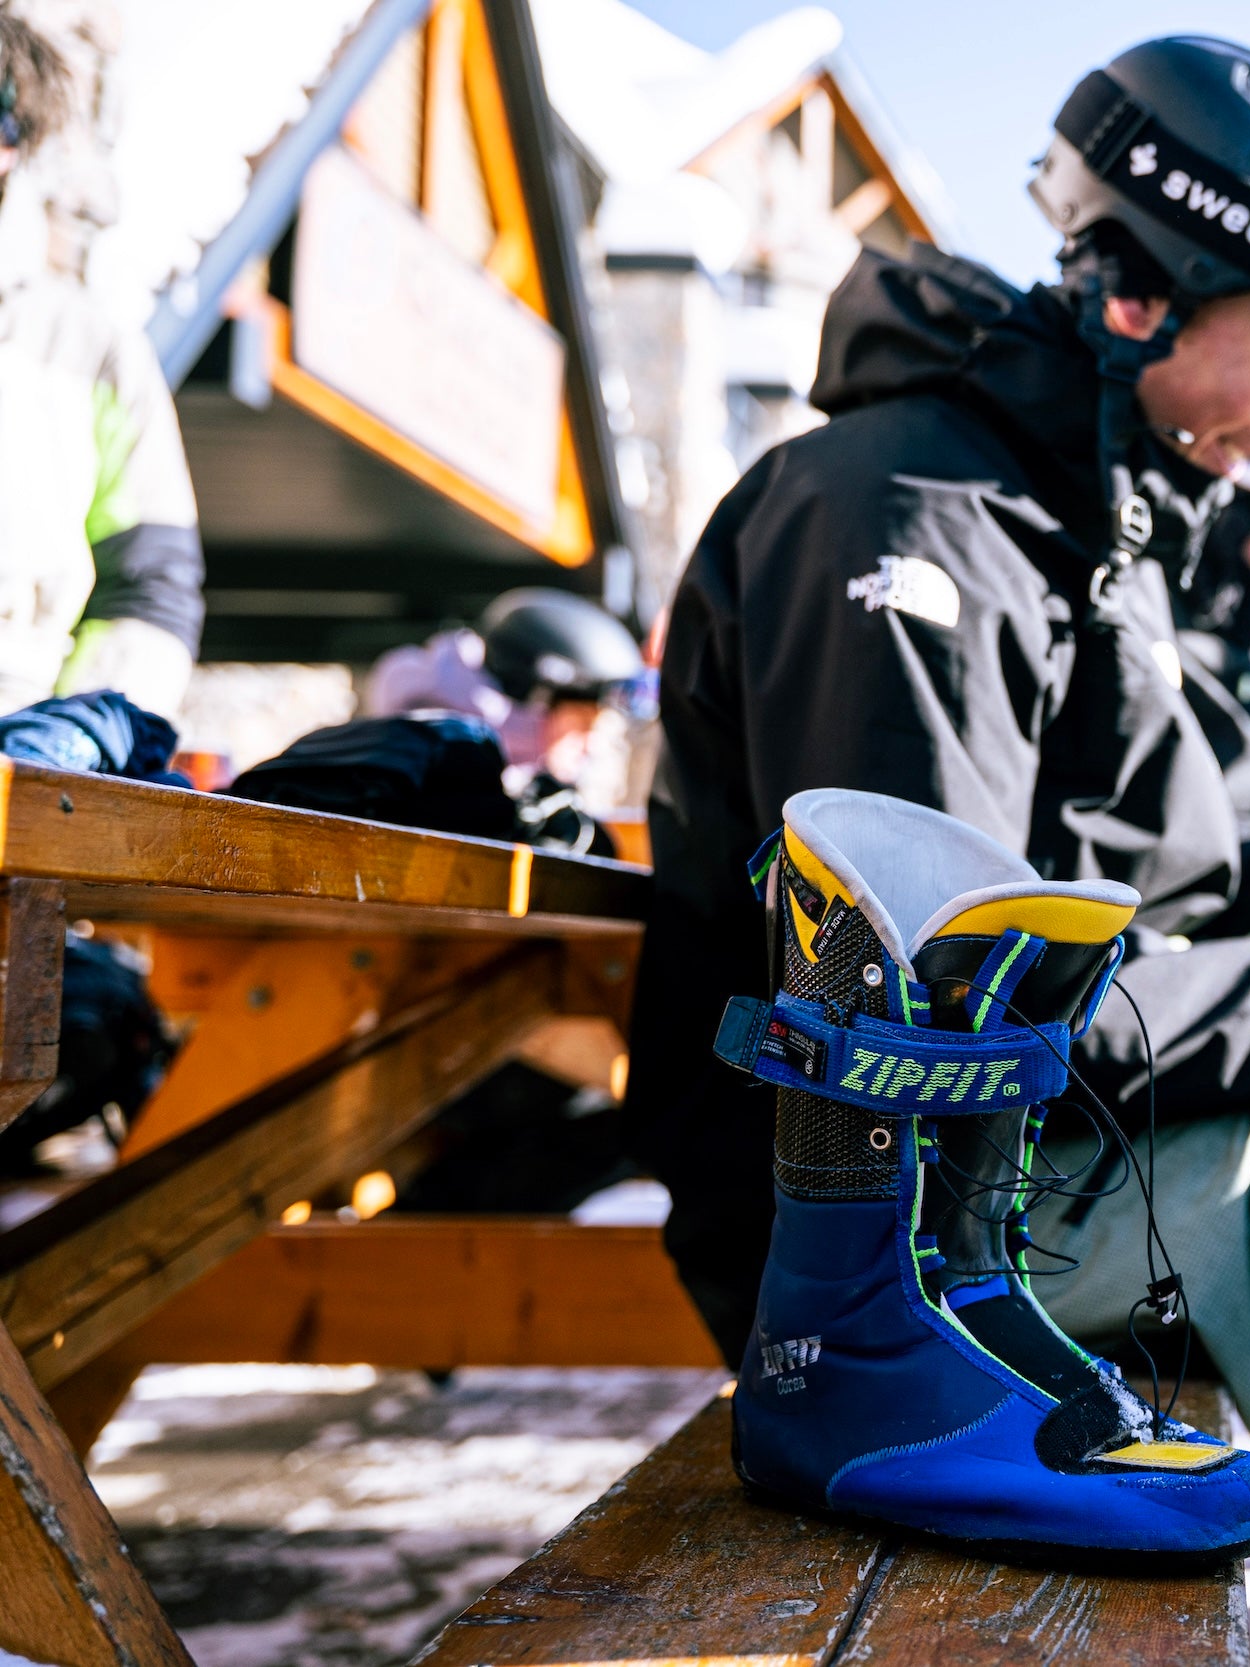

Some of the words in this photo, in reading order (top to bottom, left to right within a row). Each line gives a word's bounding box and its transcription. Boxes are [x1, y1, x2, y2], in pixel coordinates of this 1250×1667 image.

[830, 909, 846, 930] MADE
[825, 928, 834, 938] IN
[816, 936, 829, 956] ITALY
[839, 1048, 1021, 1103] ZIPFIT
